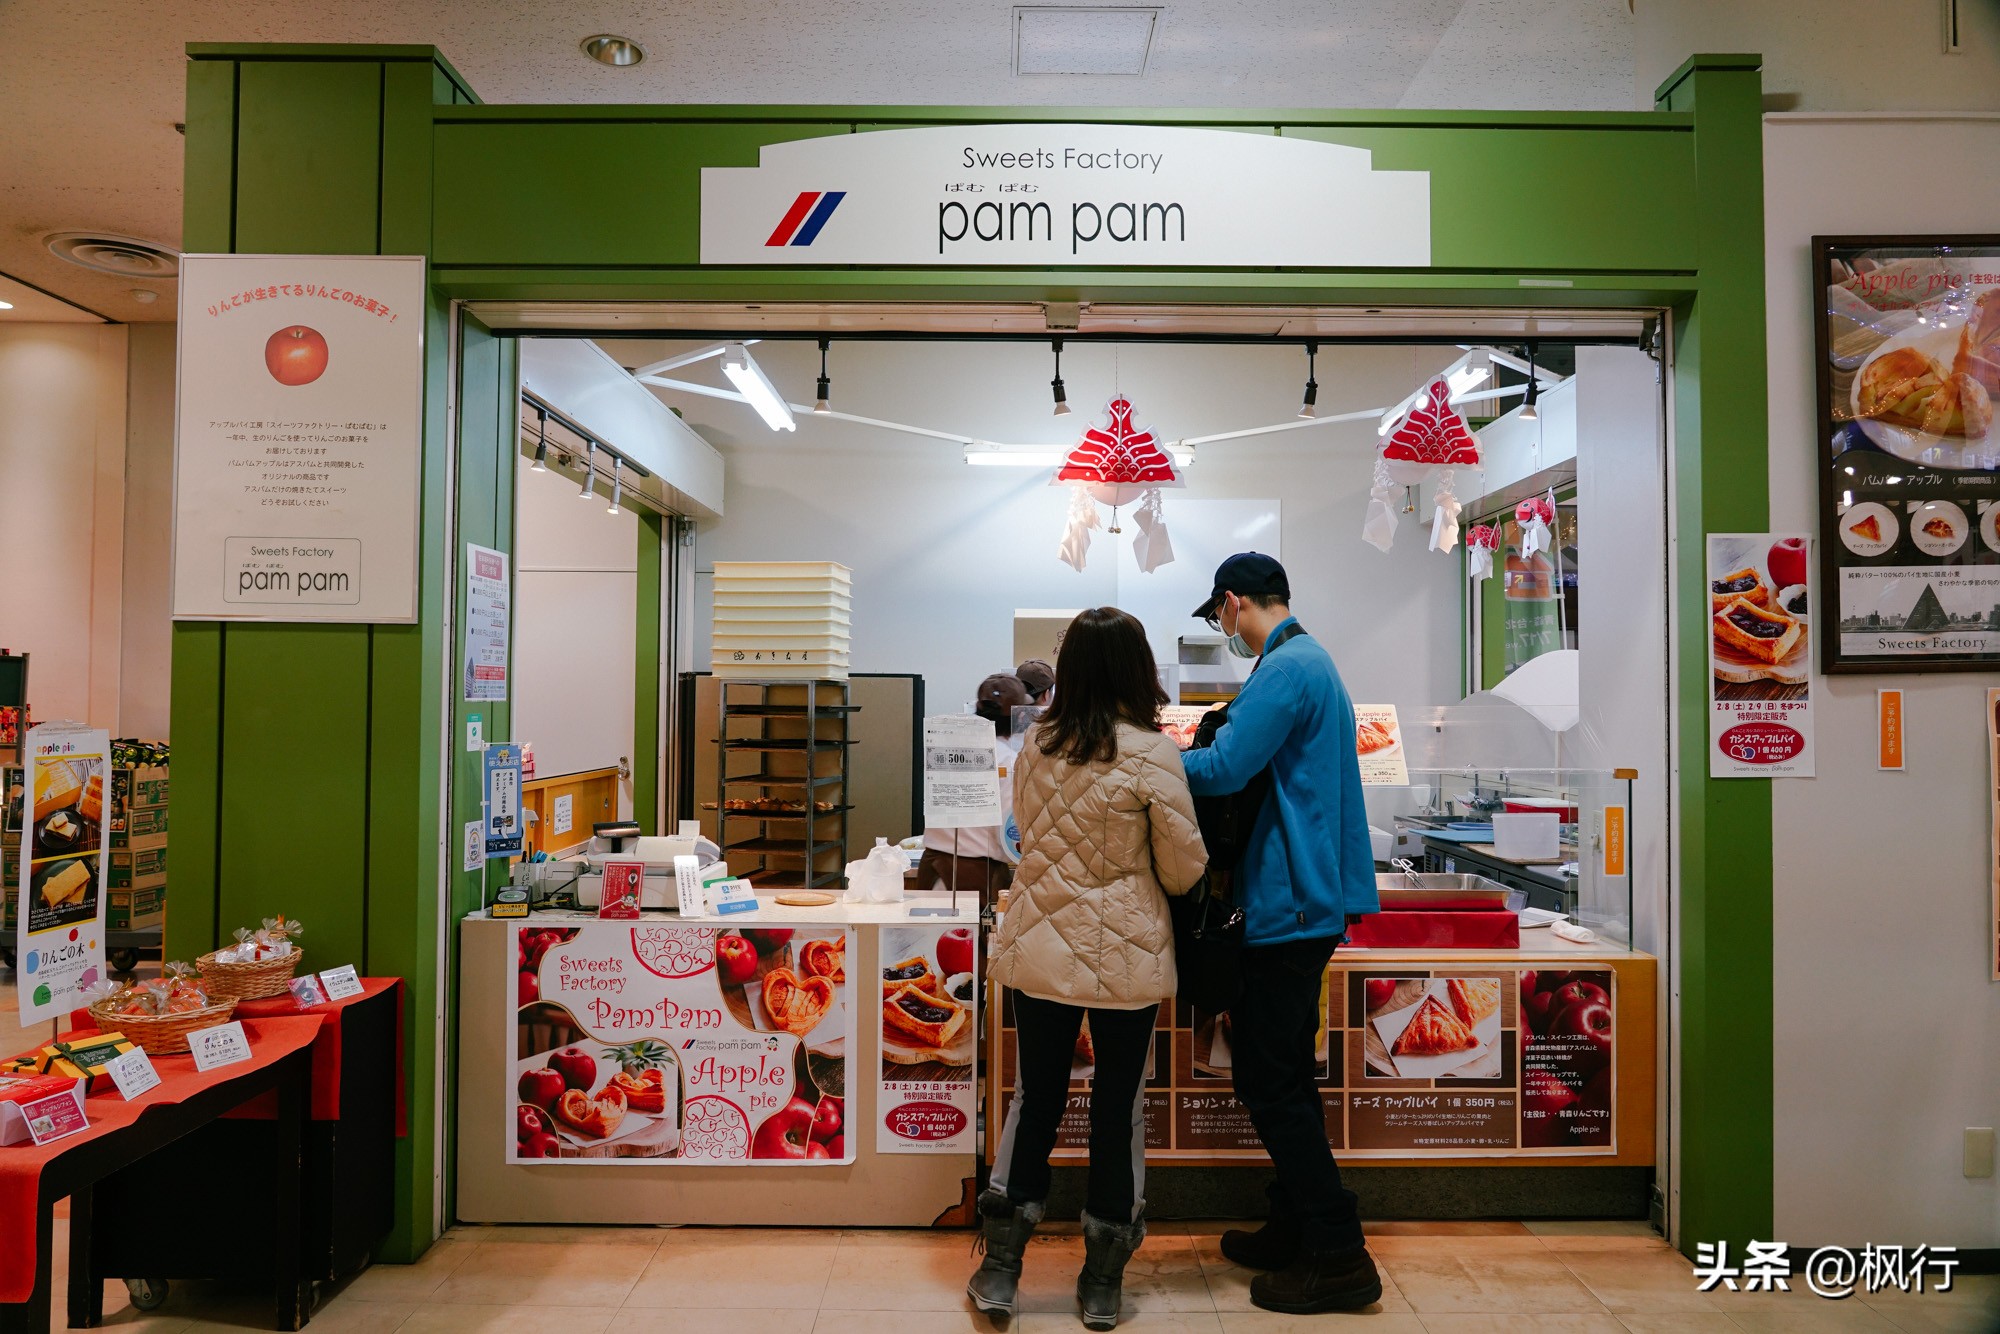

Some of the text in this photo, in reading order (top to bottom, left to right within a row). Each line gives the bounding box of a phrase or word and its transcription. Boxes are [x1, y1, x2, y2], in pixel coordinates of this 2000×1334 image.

[962, 146, 1164, 175] Sweets Factory
[944, 183, 1039, 193] ぱむ ぱむ
[939, 201, 1185, 255] pam pam
[1845, 267, 1963, 298] Apple pie
[1906, 474, 1943, 486] アップル
[251, 546, 335, 558] Sweets Factory
[239, 571, 349, 597] pam pam
[1878, 637, 1988, 651] Sweets Factory
[1737, 711, 1788, 721] 特別限定販売
[1729, 734, 1796, 744] カシスアップルパイ
[36, 743, 76, 755] apple pie
[948, 754, 965, 763] 500
[42, 942, 86, 967] りんごの木
[560, 955, 623, 973] Sweets
[559, 974, 627, 994] Factory
[718, 1042, 761, 1051] pam pam
[690, 1054, 785, 1093] Apple
[749, 1091, 778, 1112] pie
[904, 1092, 952, 1101] 特別限定販売
[1353, 1096, 1382, 1108] チーズ
[1384, 1096, 1439, 1108] アップルパイ
[1465, 1098, 1495, 1108] 350円
[895, 1112, 959, 1122] カシスアップルパイ
[1569, 1125, 1601, 1134] Apple pie
